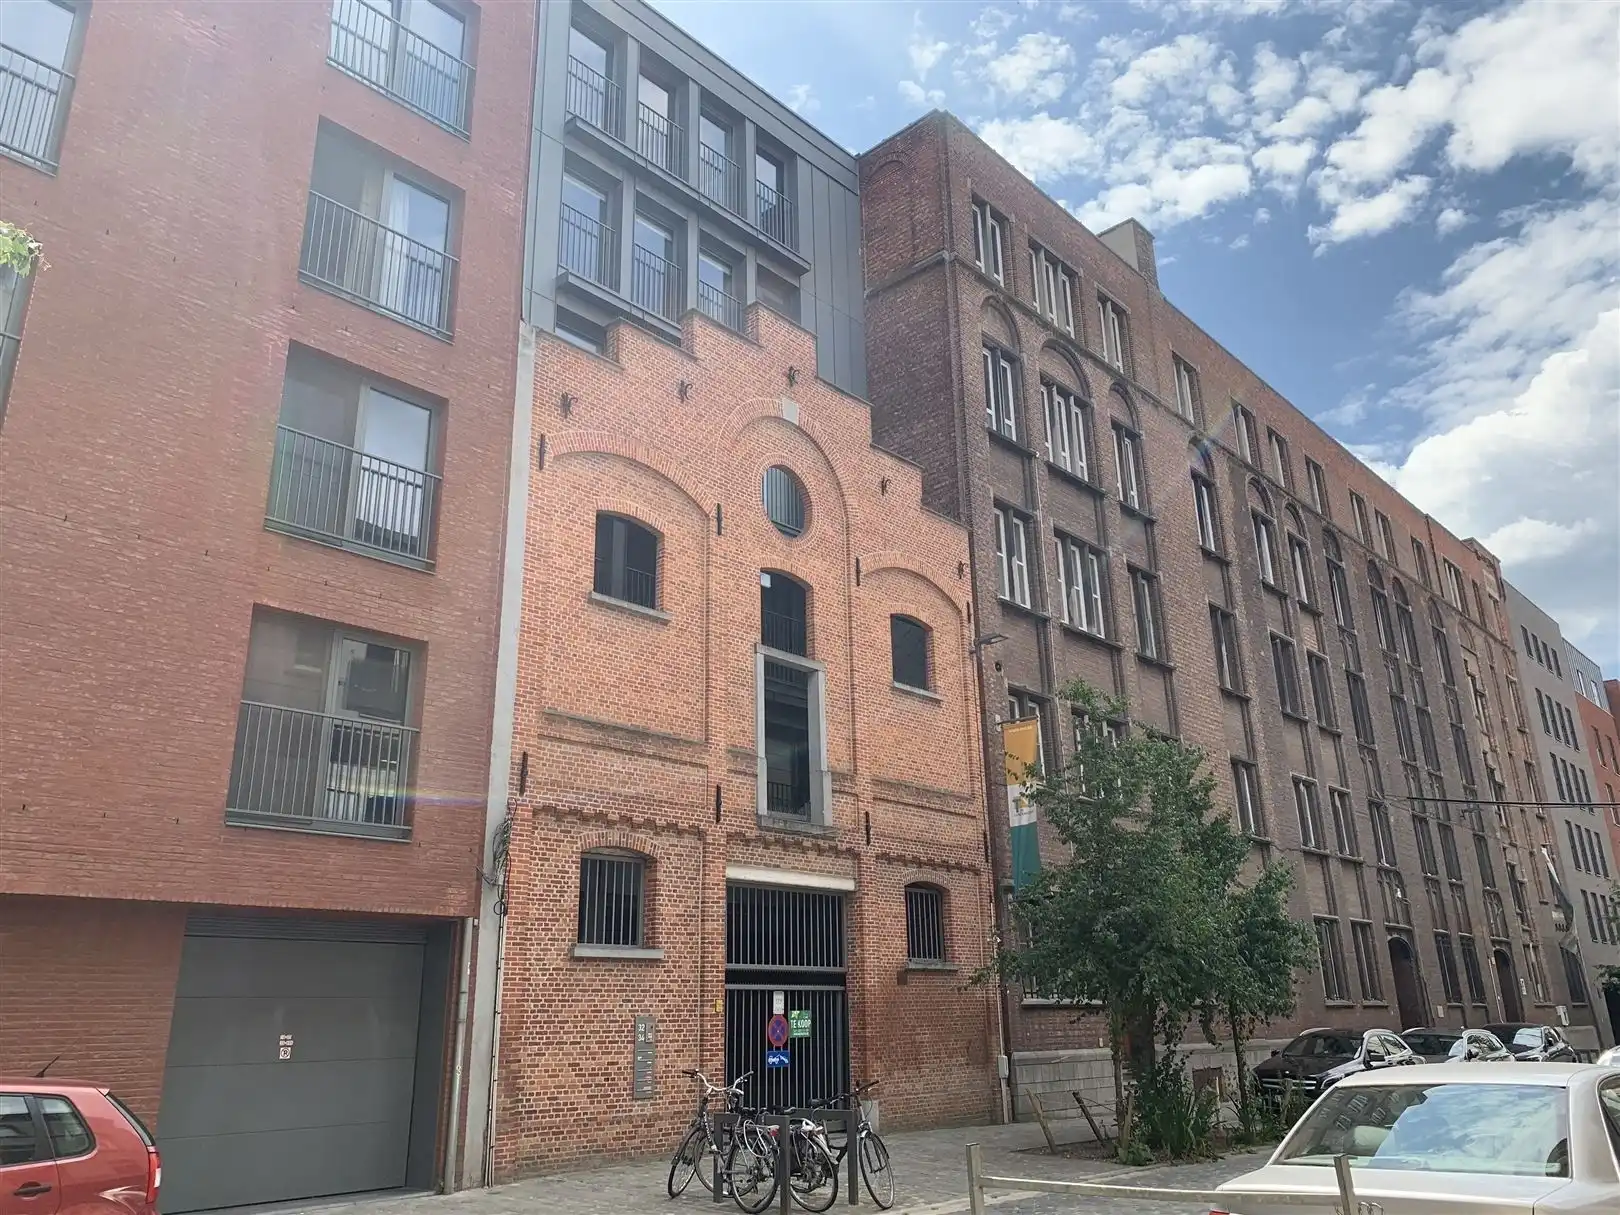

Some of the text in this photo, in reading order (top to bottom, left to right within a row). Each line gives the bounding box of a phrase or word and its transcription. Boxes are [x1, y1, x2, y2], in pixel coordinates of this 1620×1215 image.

[638, 1023, 645, 1032] 32
[790, 1019, 811, 1029] TE KOOP
[637, 1033, 645, 1042] 34
